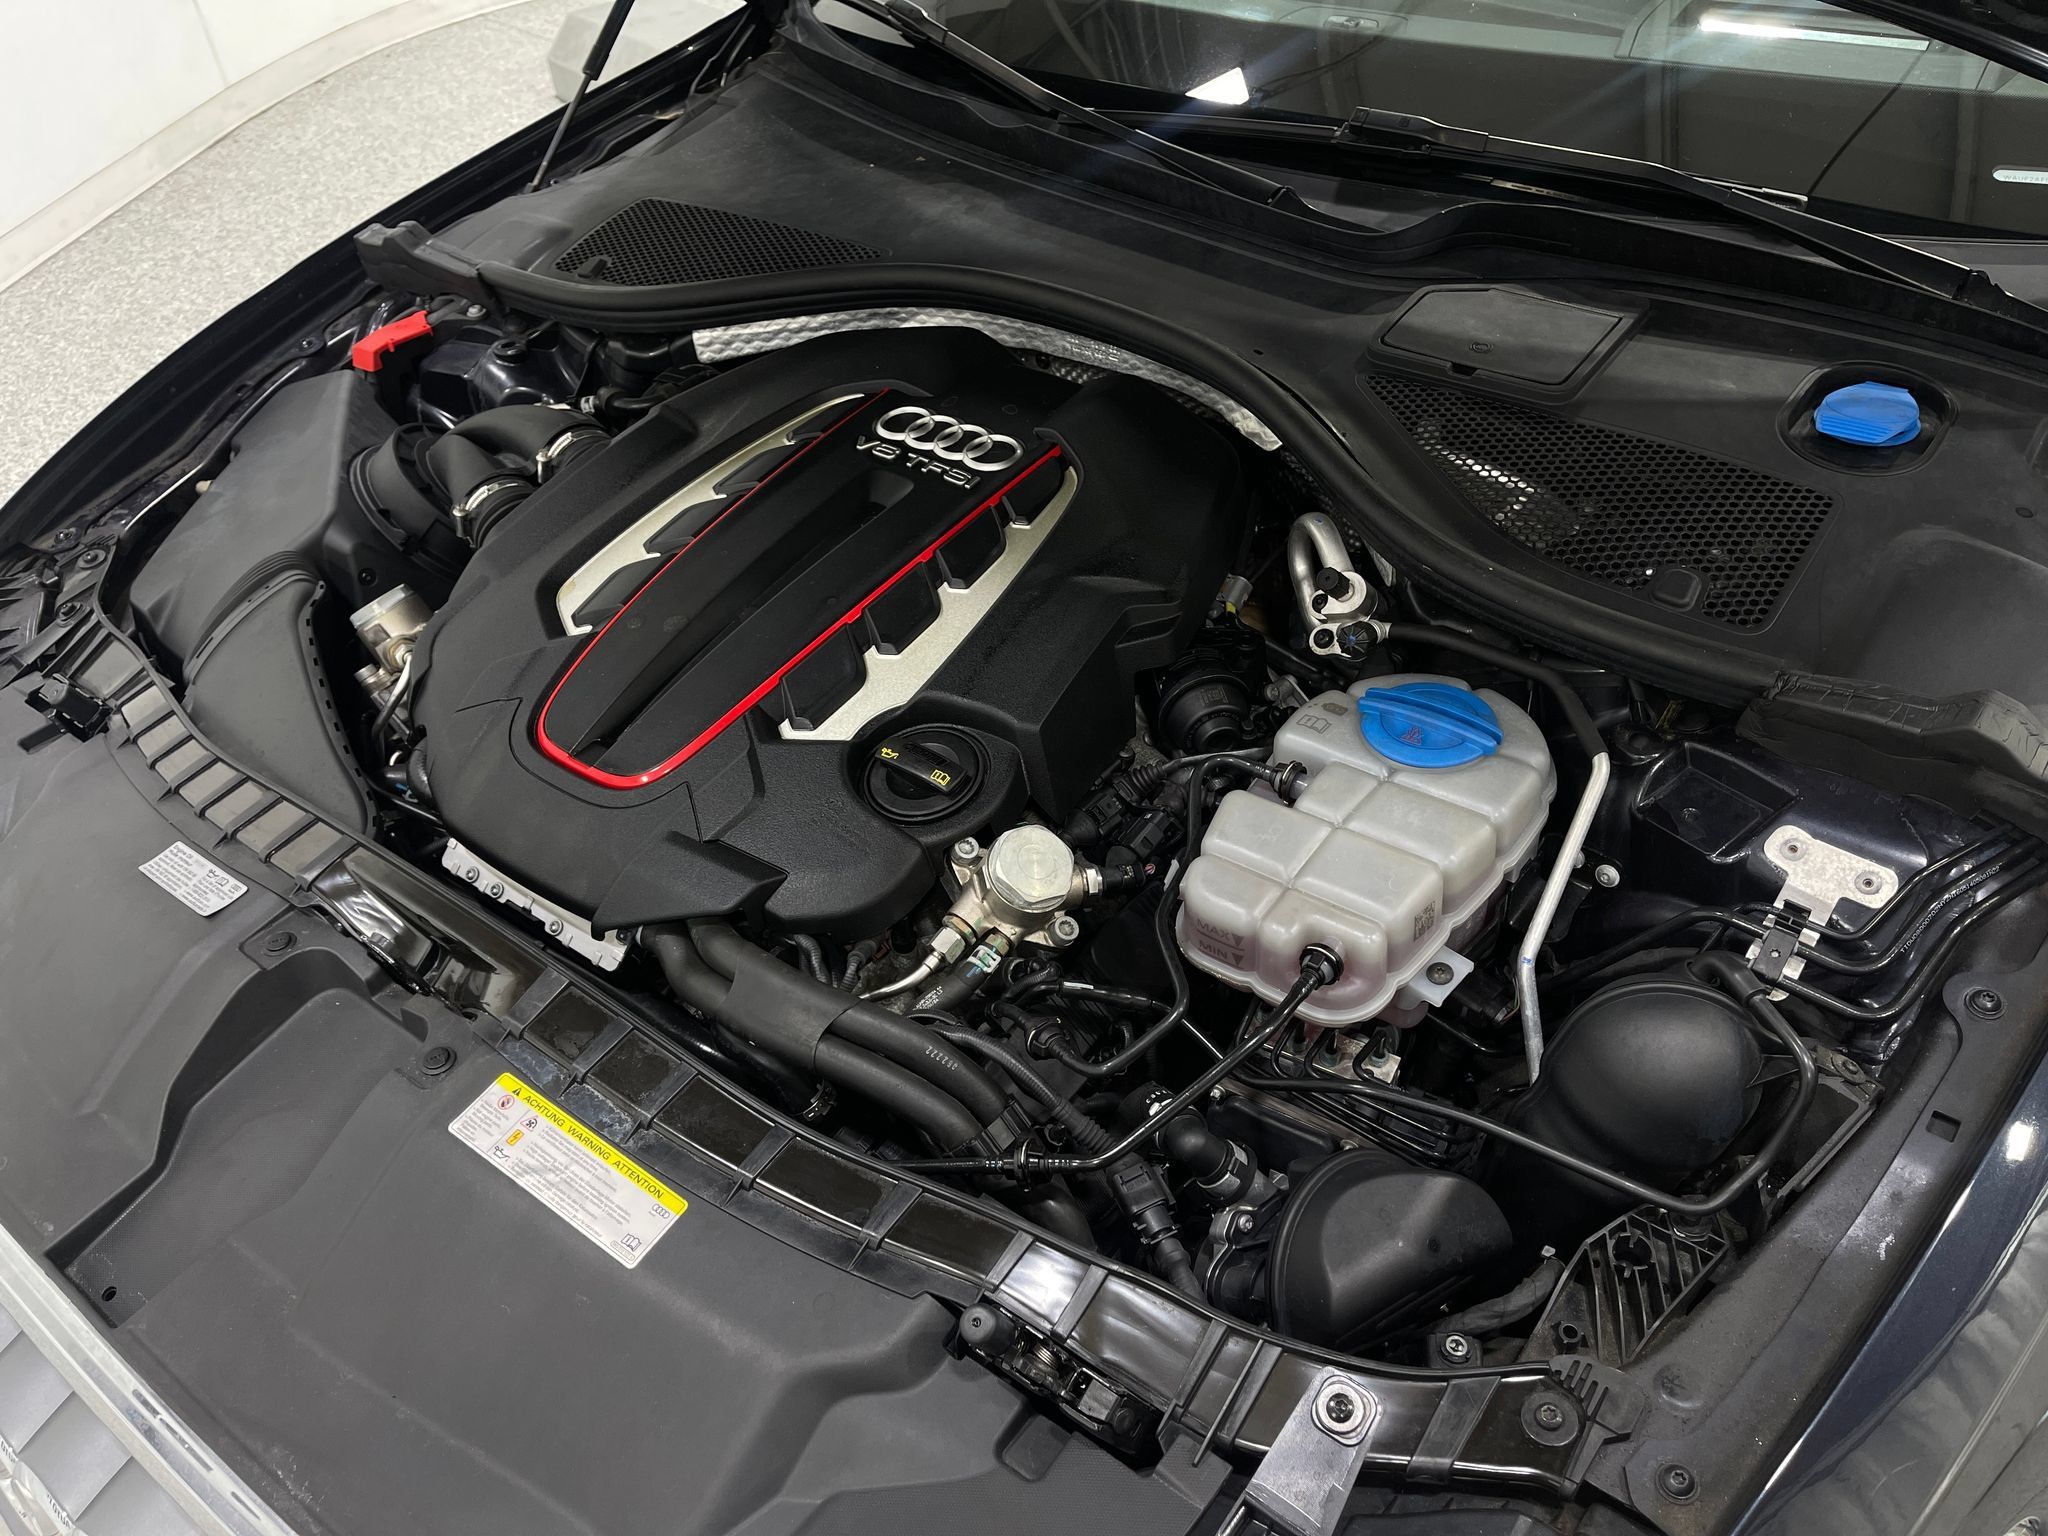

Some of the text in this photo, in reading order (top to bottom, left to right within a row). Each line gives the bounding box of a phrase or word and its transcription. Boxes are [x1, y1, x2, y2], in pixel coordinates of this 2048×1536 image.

[856, 435, 981, 489] V8 TFSI
[1196, 919, 1230, 941] MAX
[1199, 940, 1228, 959] MIN
[523, 1095, 566, 1127] ACHTUNG
[568, 1125, 612, 1161] WARNING
[612, 1159, 664, 1199] ATTENTION
